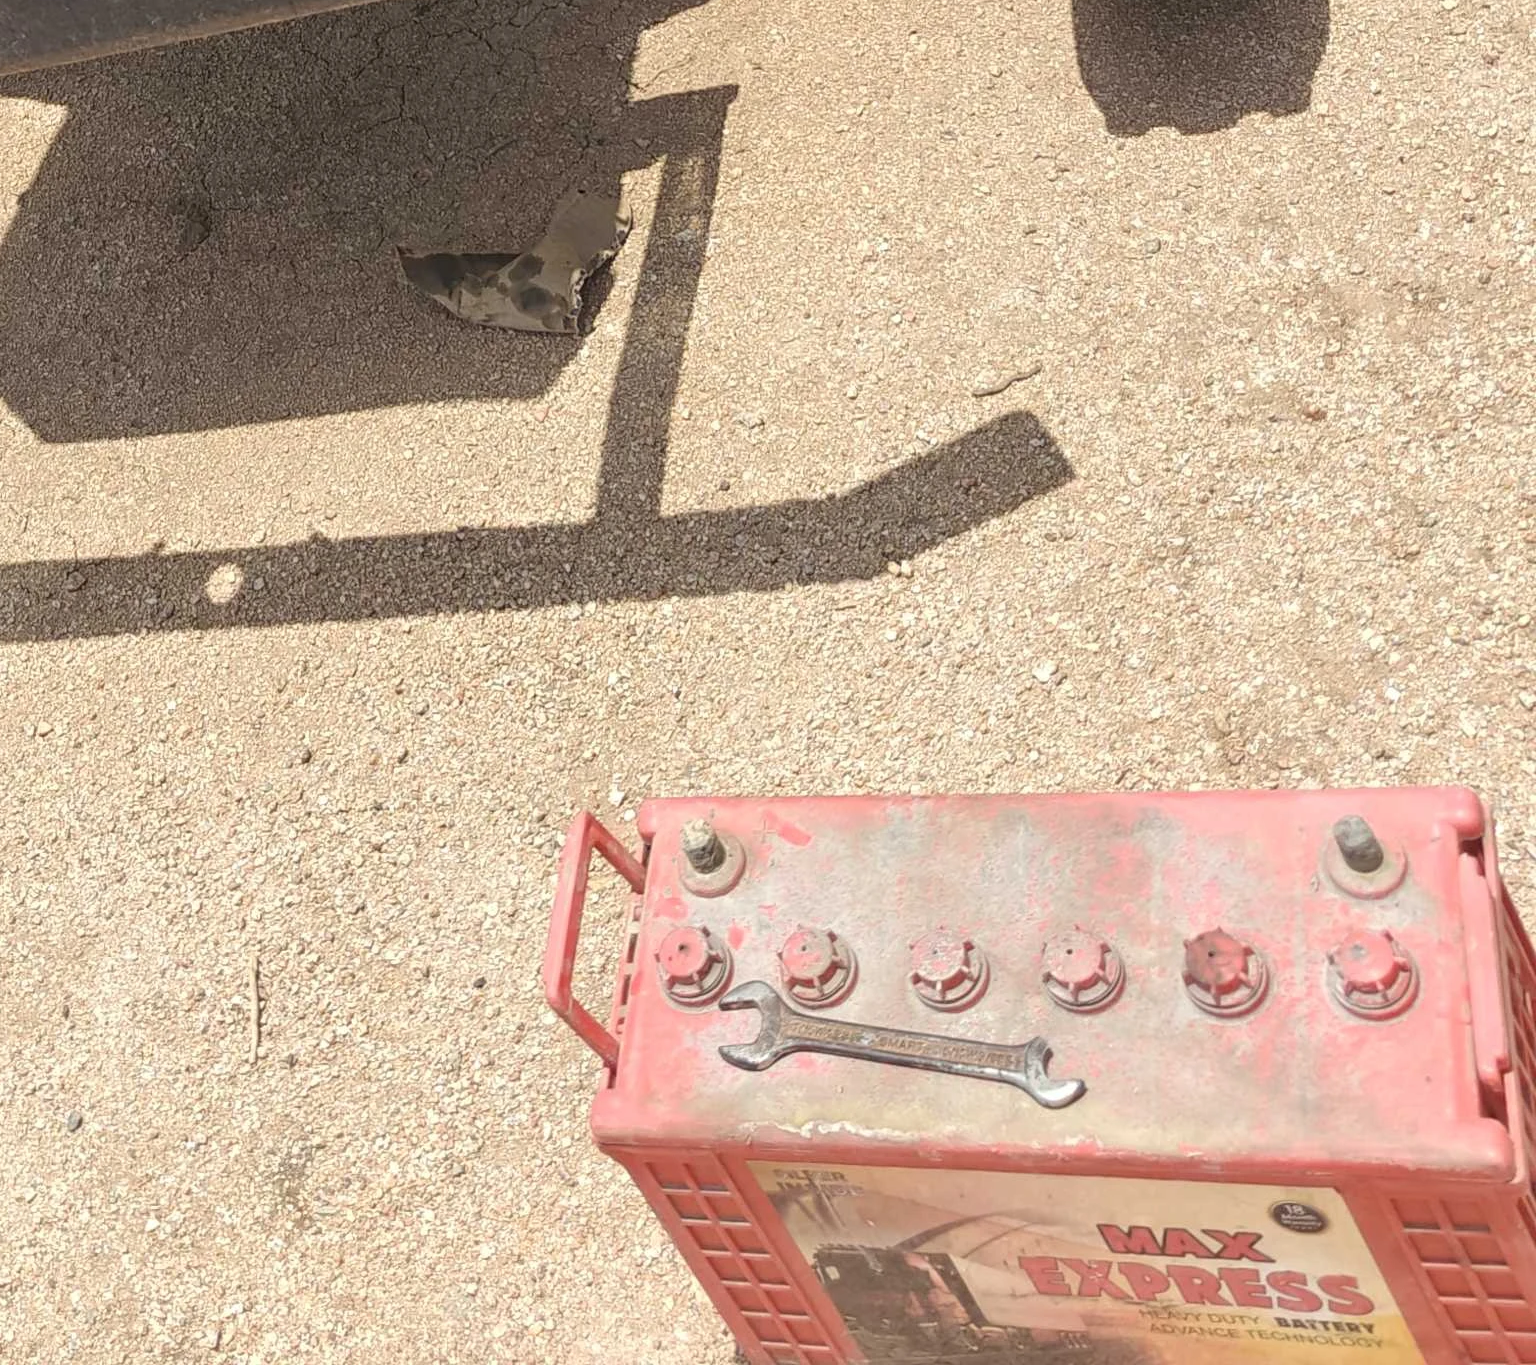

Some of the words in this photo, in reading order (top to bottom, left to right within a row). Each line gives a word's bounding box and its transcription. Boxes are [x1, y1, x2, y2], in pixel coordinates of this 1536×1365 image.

[1096, 1223, 1275, 1262] MAX
[1018, 1255, 1375, 1315] EXPRESS
[1138, 1309, 1204, 1323] HEAVY
[1207, 1312, 1259, 1326] DUTY
[1274, 1316, 1376, 1335] BATTERY
[1150, 1323, 1240, 1340] ADVANCE
[1246, 1329, 1385, 1349] TECHNOLOGY
